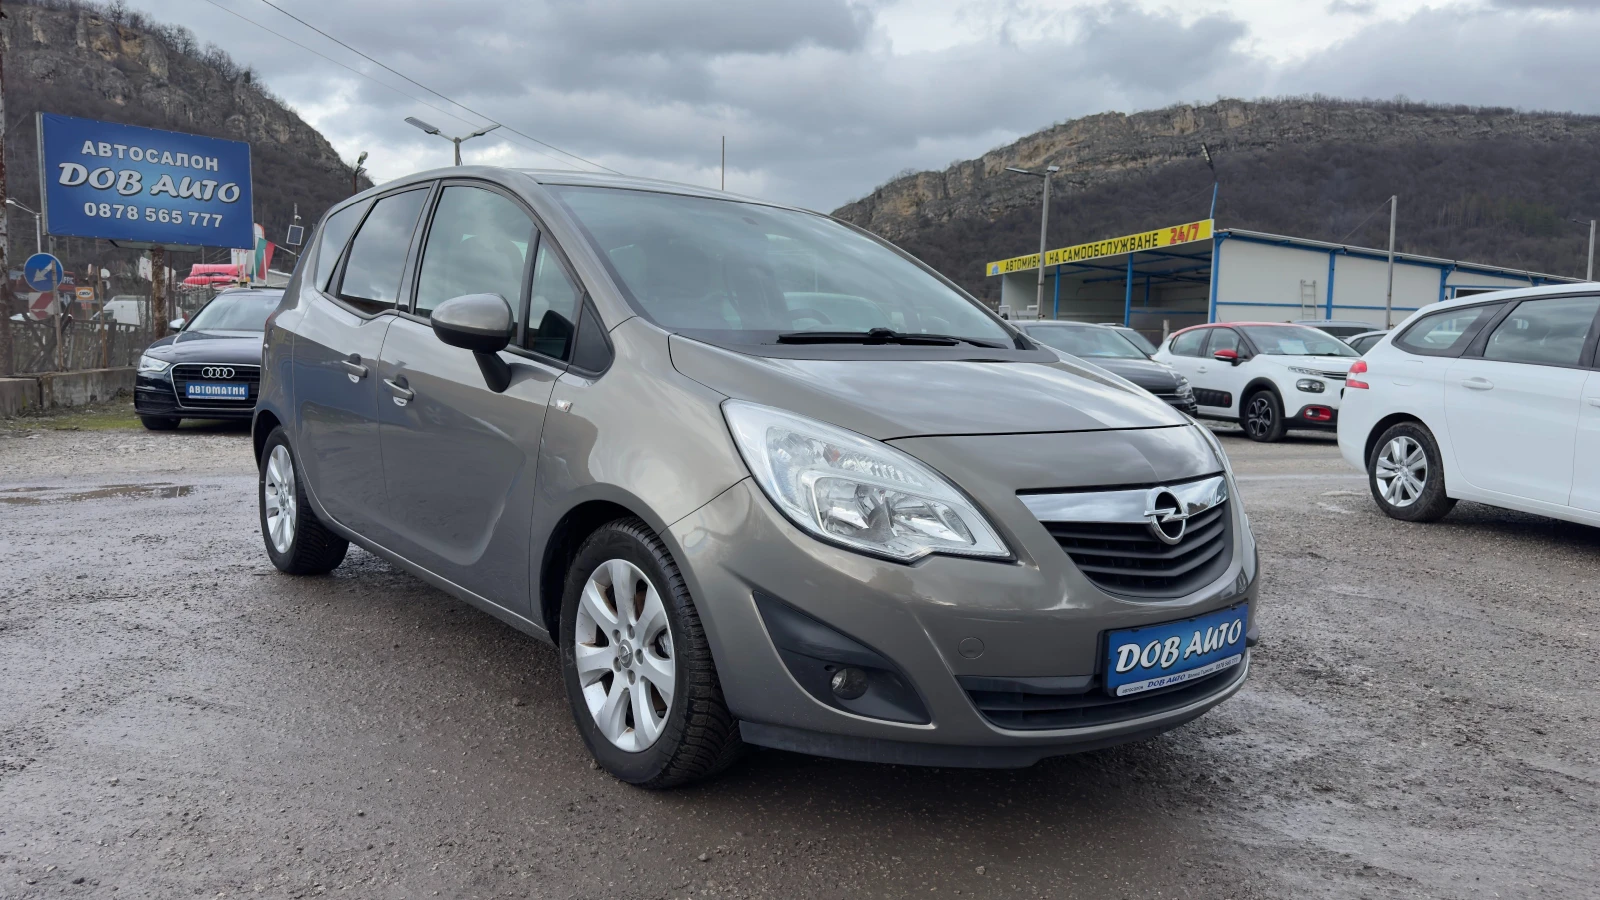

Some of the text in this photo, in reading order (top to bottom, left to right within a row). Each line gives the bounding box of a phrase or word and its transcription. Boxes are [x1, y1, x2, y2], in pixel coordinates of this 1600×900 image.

[81, 140, 218, 172] АВТОСАЛОН
[58, 163, 240, 203] DOB AUTO
[84, 202, 223, 228] 0878 565 777
[1005, 223, 1200, 272] АВТОМИВК НА САМООБСЛУЖВАНЕ 24/7
[189, 385, 245, 395] АВТОМАТИК
[1115, 618, 1242, 673] DOB AUTO
[1147, 678, 1165, 688] DOB
[1166, 674, 1186, 683] AUTO
